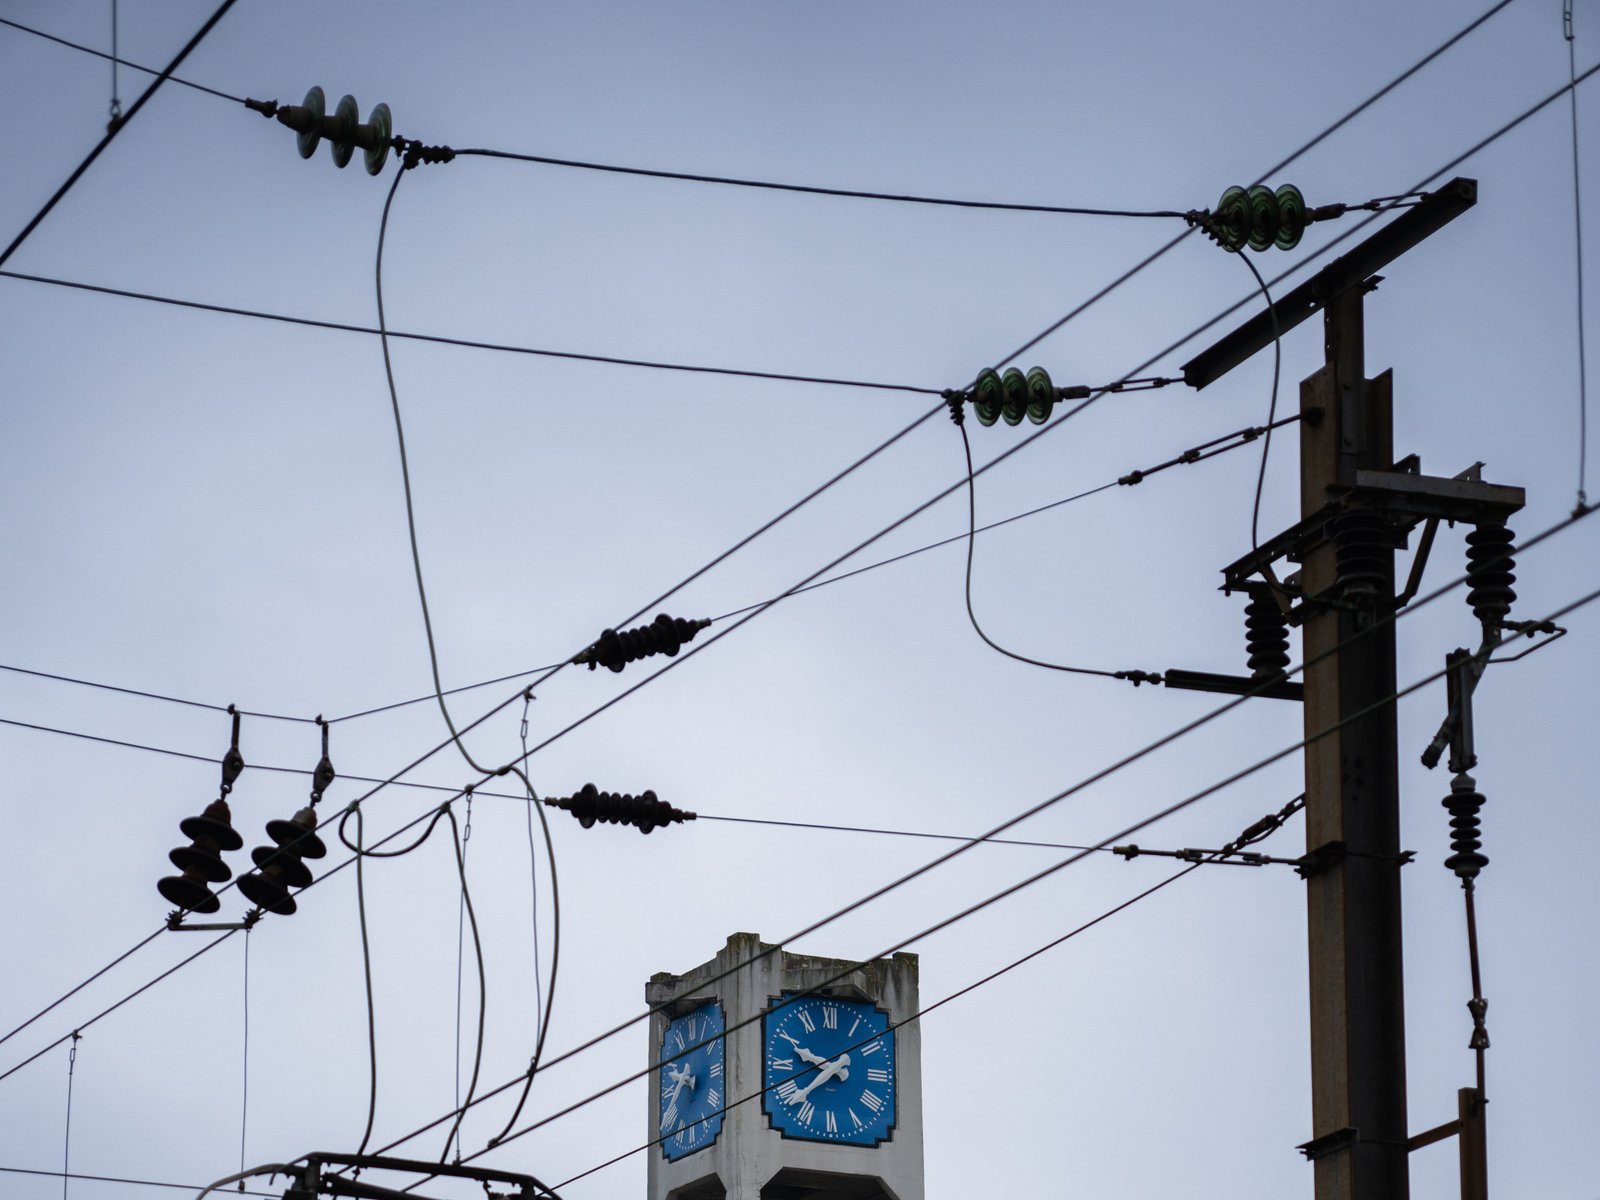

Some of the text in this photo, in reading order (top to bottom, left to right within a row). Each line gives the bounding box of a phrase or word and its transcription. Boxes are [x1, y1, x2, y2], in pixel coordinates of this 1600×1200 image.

[797, 1011, 816, 1034] XI
[823, 1006, 837, 1030] XII
[861, 1041, 881, 1056] II
[710, 1063, 721, 1078] III
[773, 1057, 793, 1070] IX
[867, 1069, 888, 1082] III
[797, 1101, 815, 1126] VII
[826, 1110, 838, 1133] VI
